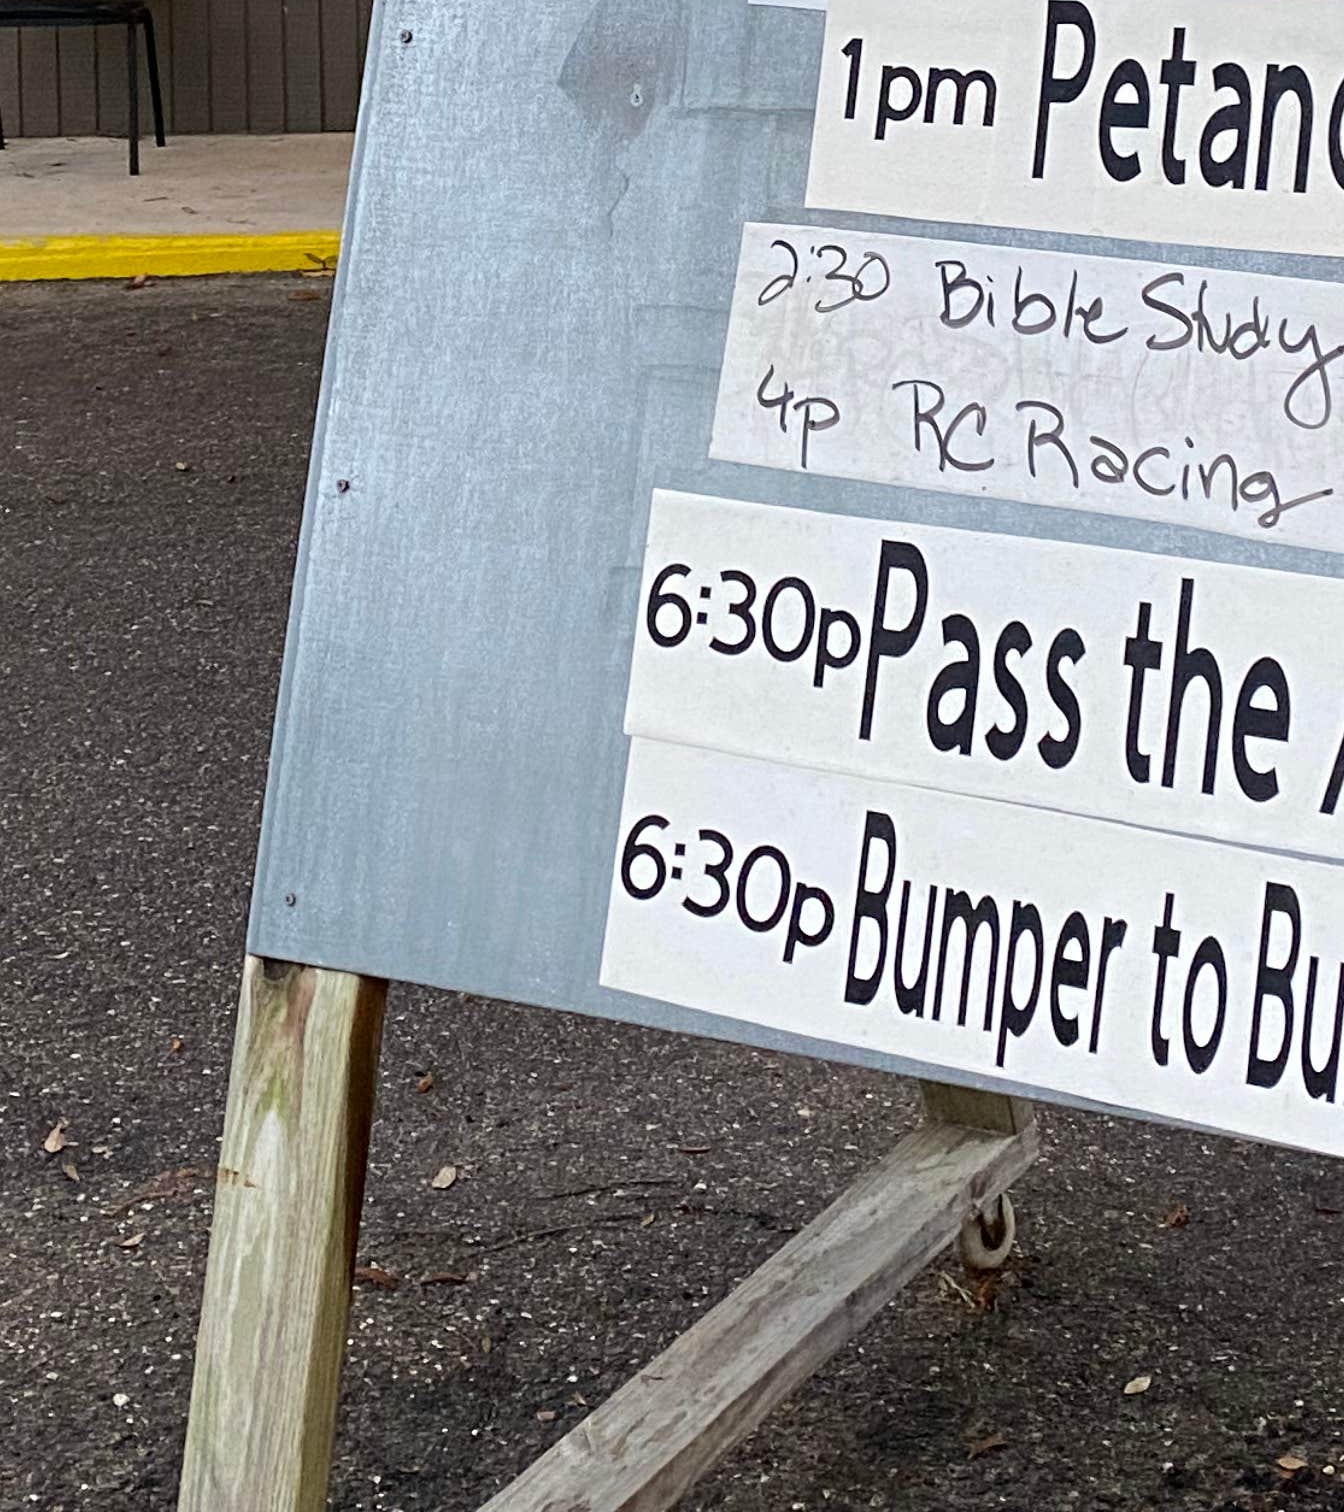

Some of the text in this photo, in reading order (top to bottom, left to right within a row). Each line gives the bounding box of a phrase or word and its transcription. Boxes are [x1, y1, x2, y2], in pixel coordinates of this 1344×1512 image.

[841, 38, 997, 141] 1pm
[935, 259, 1129, 344] Bible
[891, 379, 996, 472] RC
[1015, 399, 1334, 528] Racing
[646, 563, 861, 688] 6:30p
[860, 539, 1086, 770] Pass
[1123, 577, 1291, 802] the
[620, 814, 835, 964] 6:30p
[841, 810, 1128, 1074] Bumper
[1151, 892, 1228, 1075] to
